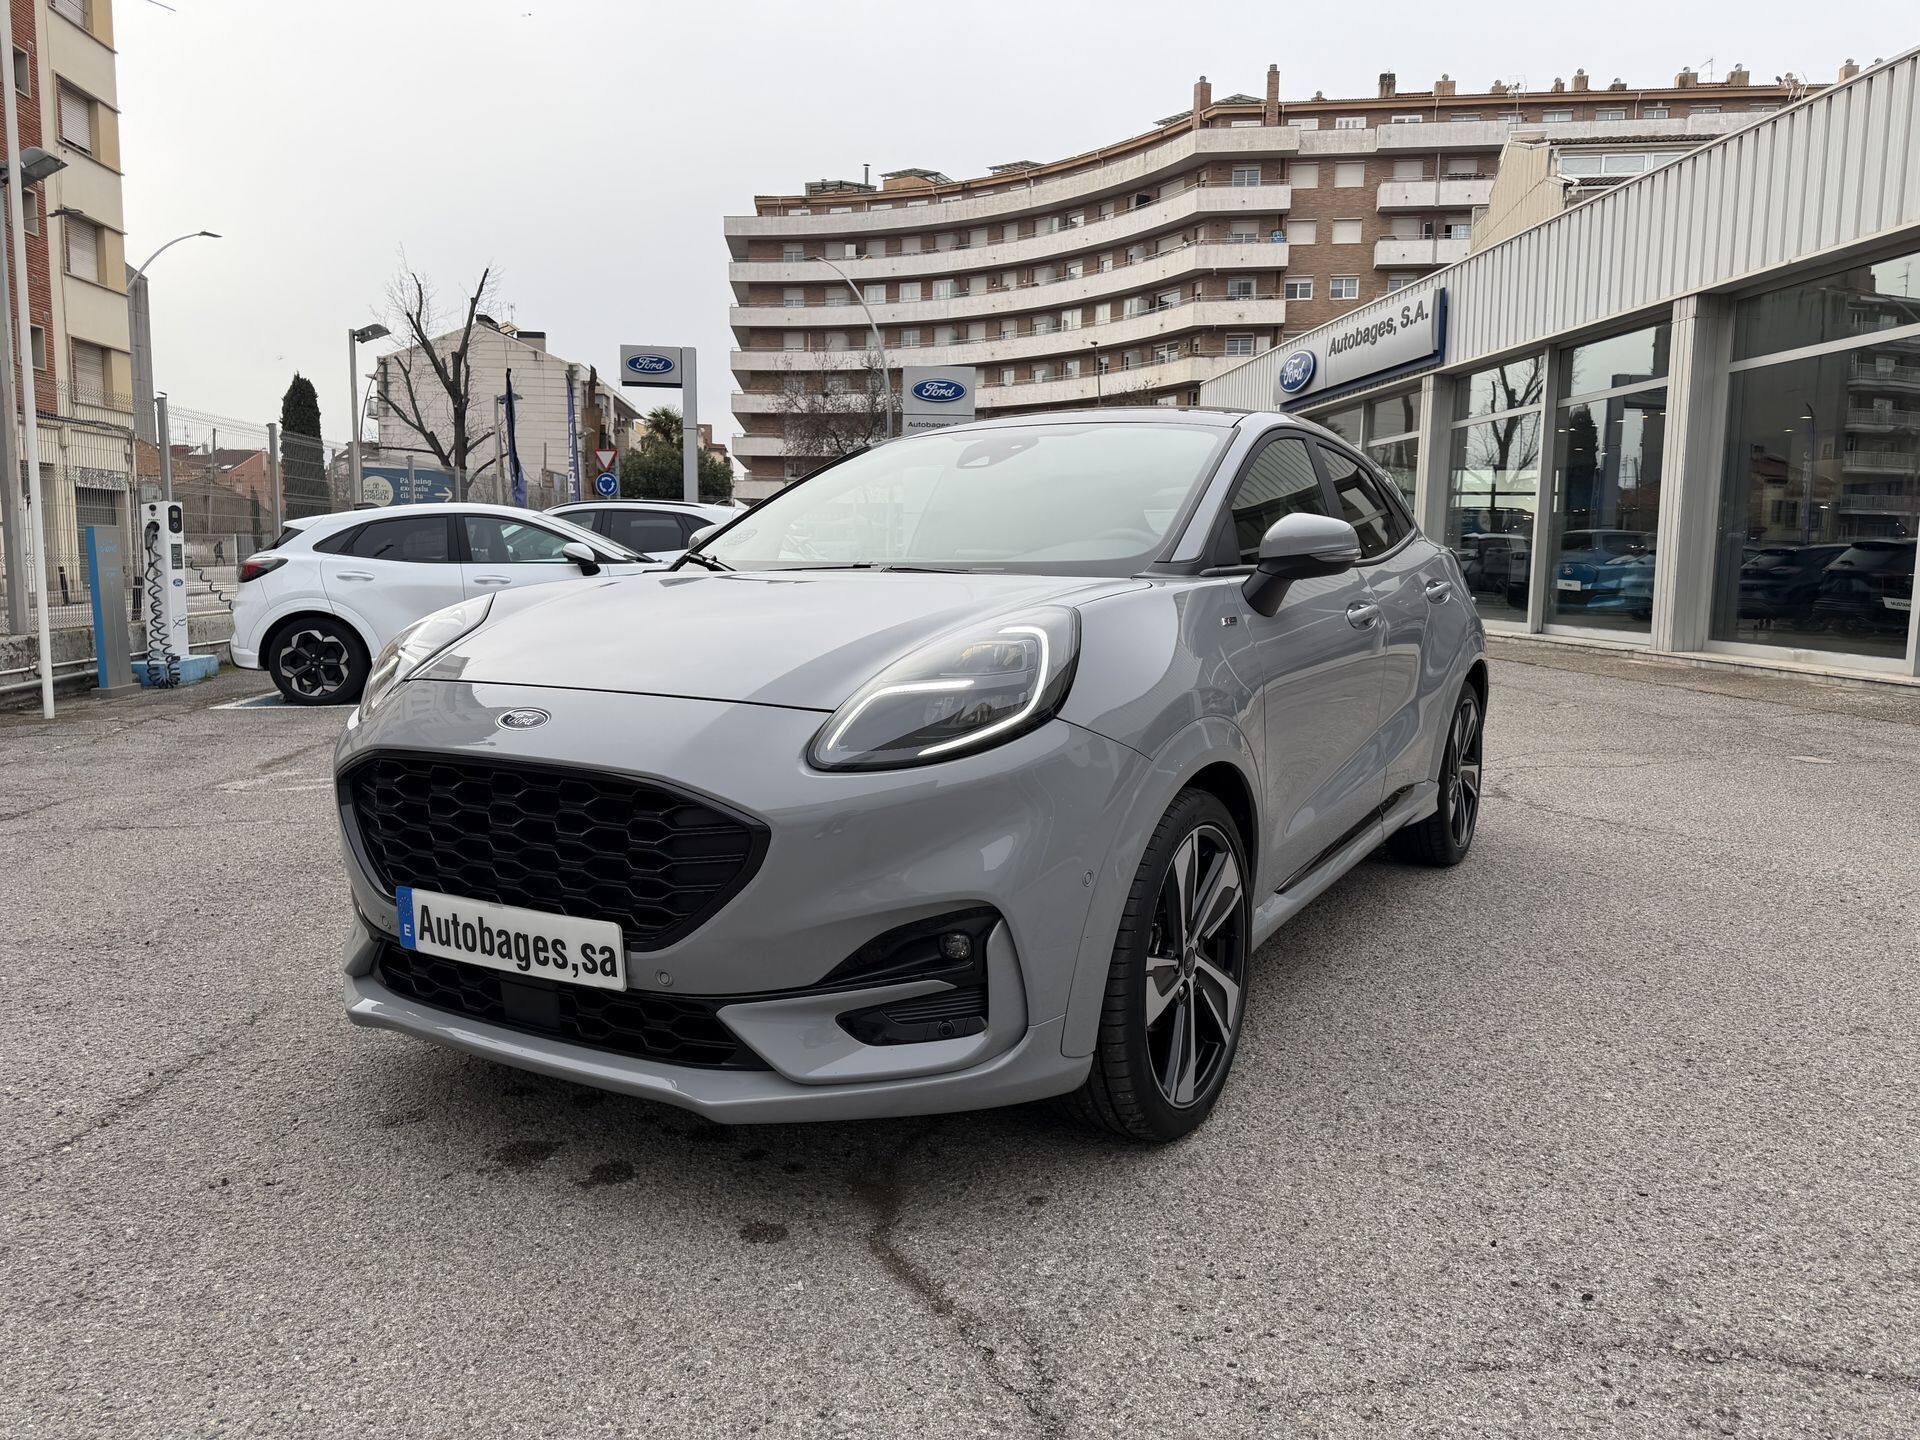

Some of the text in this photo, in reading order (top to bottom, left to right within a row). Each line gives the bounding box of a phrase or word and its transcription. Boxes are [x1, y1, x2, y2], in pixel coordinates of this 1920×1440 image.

[1328, 300, 1429, 357] Autobages, S.A.
[636, 357, 665, 370] Ford
[1283, 357, 1306, 385] Ford
[922, 382, 955, 397] Ford
[508, 712, 538, 725] Ford
[404, 923, 412, 937] E
[419, 905, 618, 978] Autobages,sa
